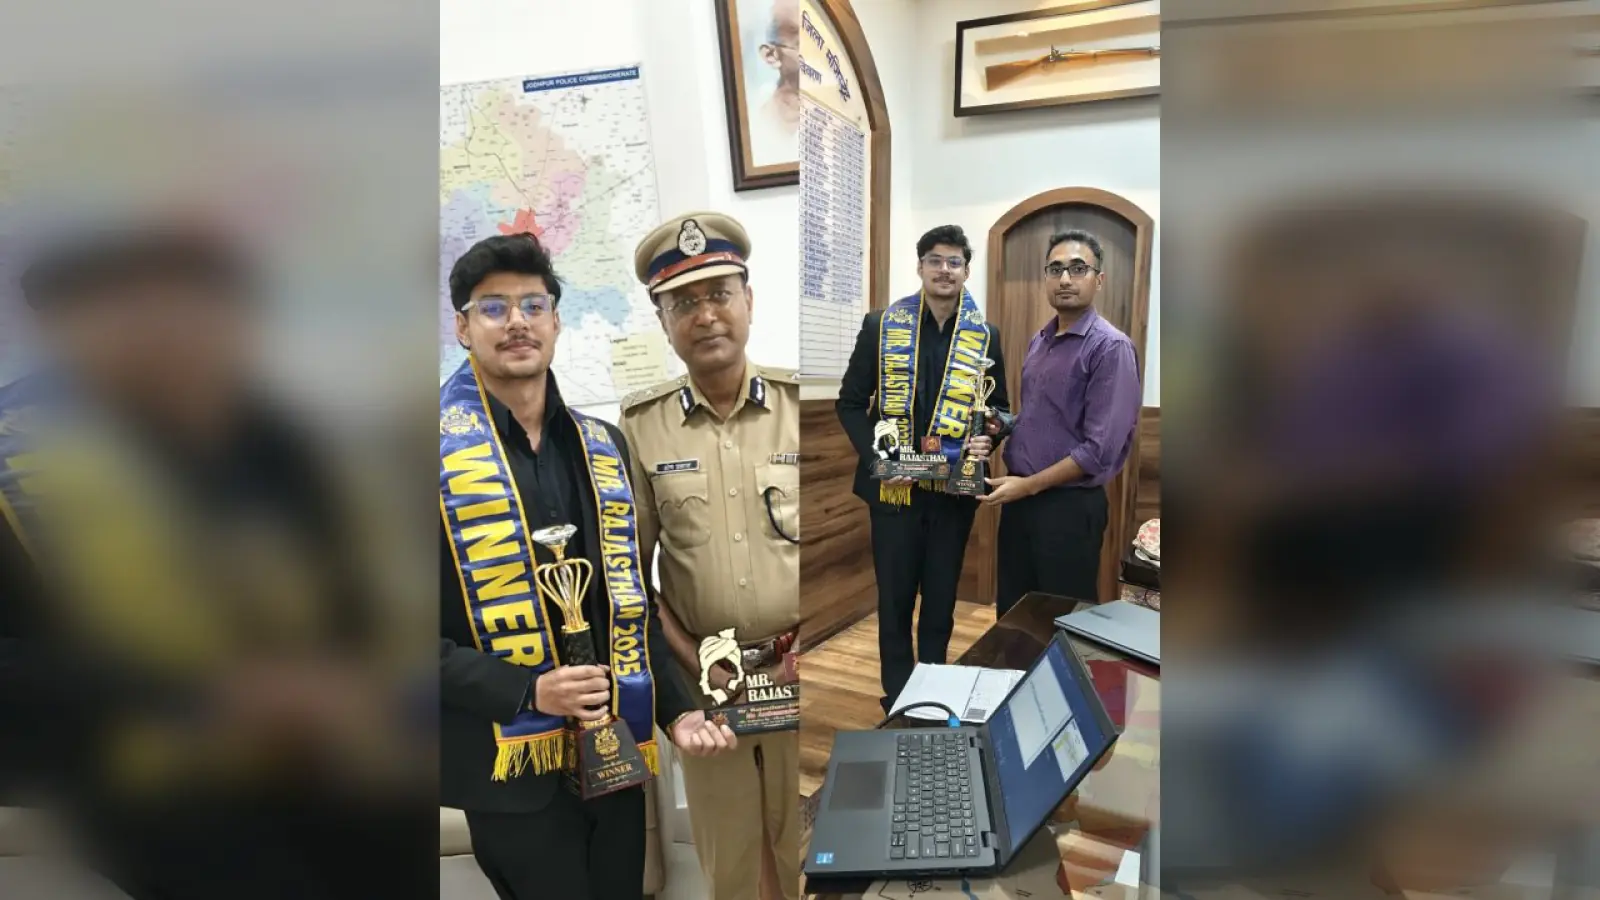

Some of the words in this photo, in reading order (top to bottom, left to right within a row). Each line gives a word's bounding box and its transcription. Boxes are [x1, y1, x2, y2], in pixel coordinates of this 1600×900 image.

[525, 80, 555, 89] JODHPUR
[556, 76, 578, 85] POLICE
[579, 69, 637, 83] COMMISSIONERATE
[884, 353, 911, 416] RAJASTHAN
[936, 329, 986, 438] WINNER
[900, 453, 948, 462] RAJASTHAN
[442, 442, 545, 667] WINNER
[602, 500, 645, 619] RAJASTHAN
[613, 623, 642, 677] 2025
[745, 673, 774, 689] MR.
[597, 763, 633, 779] WINNER
